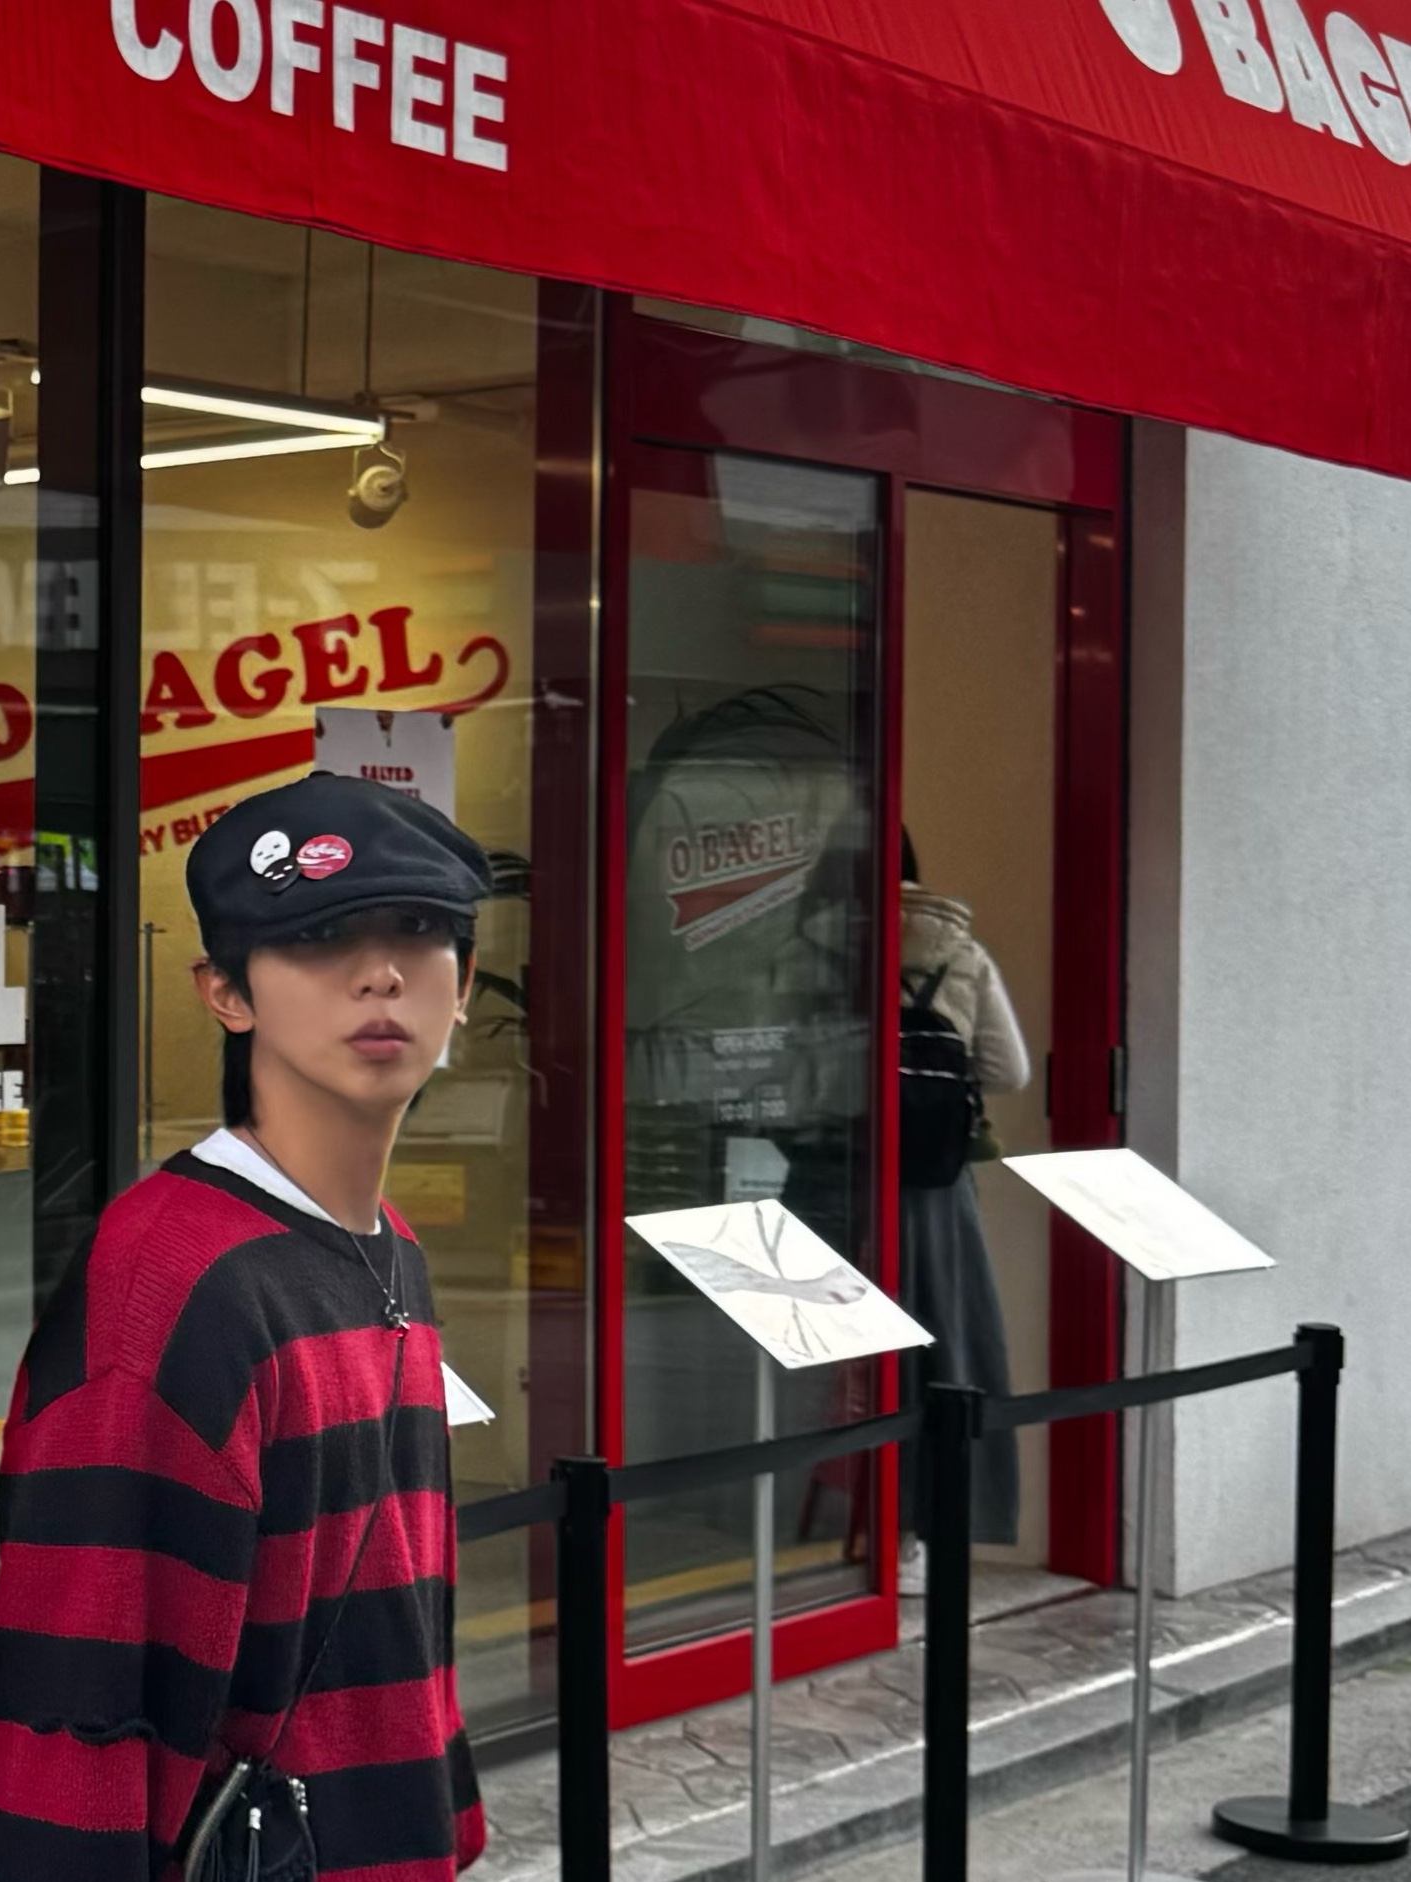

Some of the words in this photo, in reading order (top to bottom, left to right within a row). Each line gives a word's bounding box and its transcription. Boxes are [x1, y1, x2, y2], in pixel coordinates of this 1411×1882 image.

[111, 0, 508, 171] COFFEE
[140, 606, 441, 733] AGEL
[668, 837, 692, 883] O
[699, 814, 804, 876] BAGEL
